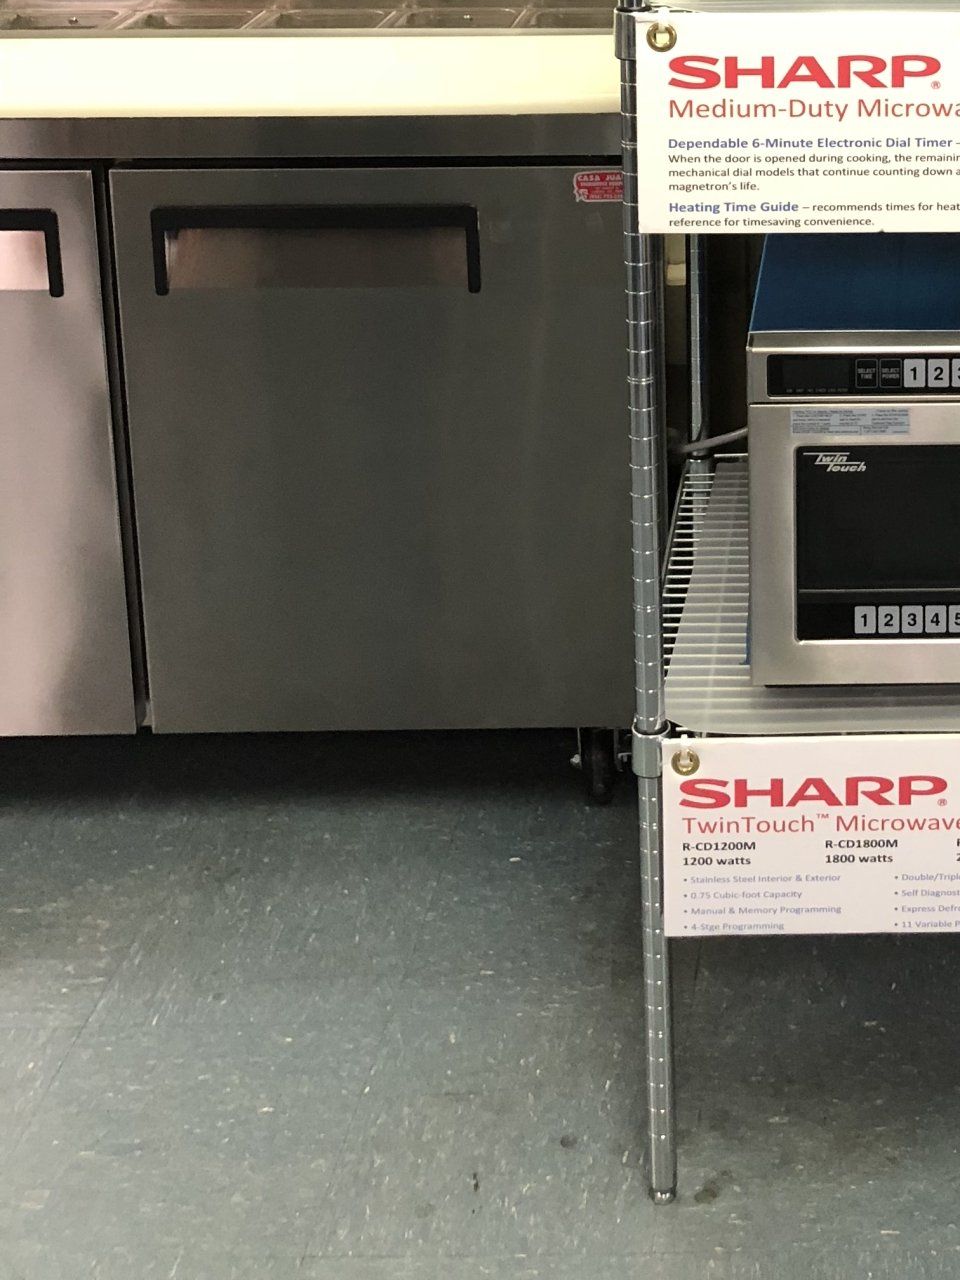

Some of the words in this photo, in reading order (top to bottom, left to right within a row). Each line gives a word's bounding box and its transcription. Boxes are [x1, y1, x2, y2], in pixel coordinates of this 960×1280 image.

[669, 98, 848, 120] Medium-Duty
[669, 138, 748, 150] Dependable
[752, 138, 813, 148] 6-Minute
[818, 138, 882, 147] Electronic
[886, 137, 910, 147] Dial
[915, 138, 953, 147] Timer
[669, 202, 720, 214] Heating
[724, 202, 756, 212] Time
[760, 202, 799, 211] Guide
[813, 203, 882, 211] recommends
[886, 203, 915, 211] times
[918, 202, 934, 211] for
[669, 218, 721, 227] reference
[724, 217, 740, 226] for
[743, 218, 801, 228] timesaving
[804, 217, 874, 226] convenience.
[910, 367, 917, 381] 1
[934, 367, 943, 381] 2
[861, 613, 867, 627] 1
[884, 613, 893, 627] 2
[908, 613, 917, 626] 3
[931, 613, 940, 626] 4
[683, 842, 756, 851] R-CD1200M
[825, 839, 898, 848] R-CD1800M
[683, 857, 713, 866] 1200
[716, 857, 751, 865] watts
[826, 854, 855, 863] 1800
[859, 855, 893, 863] watts
[915, 920, 952, 928] Variable
